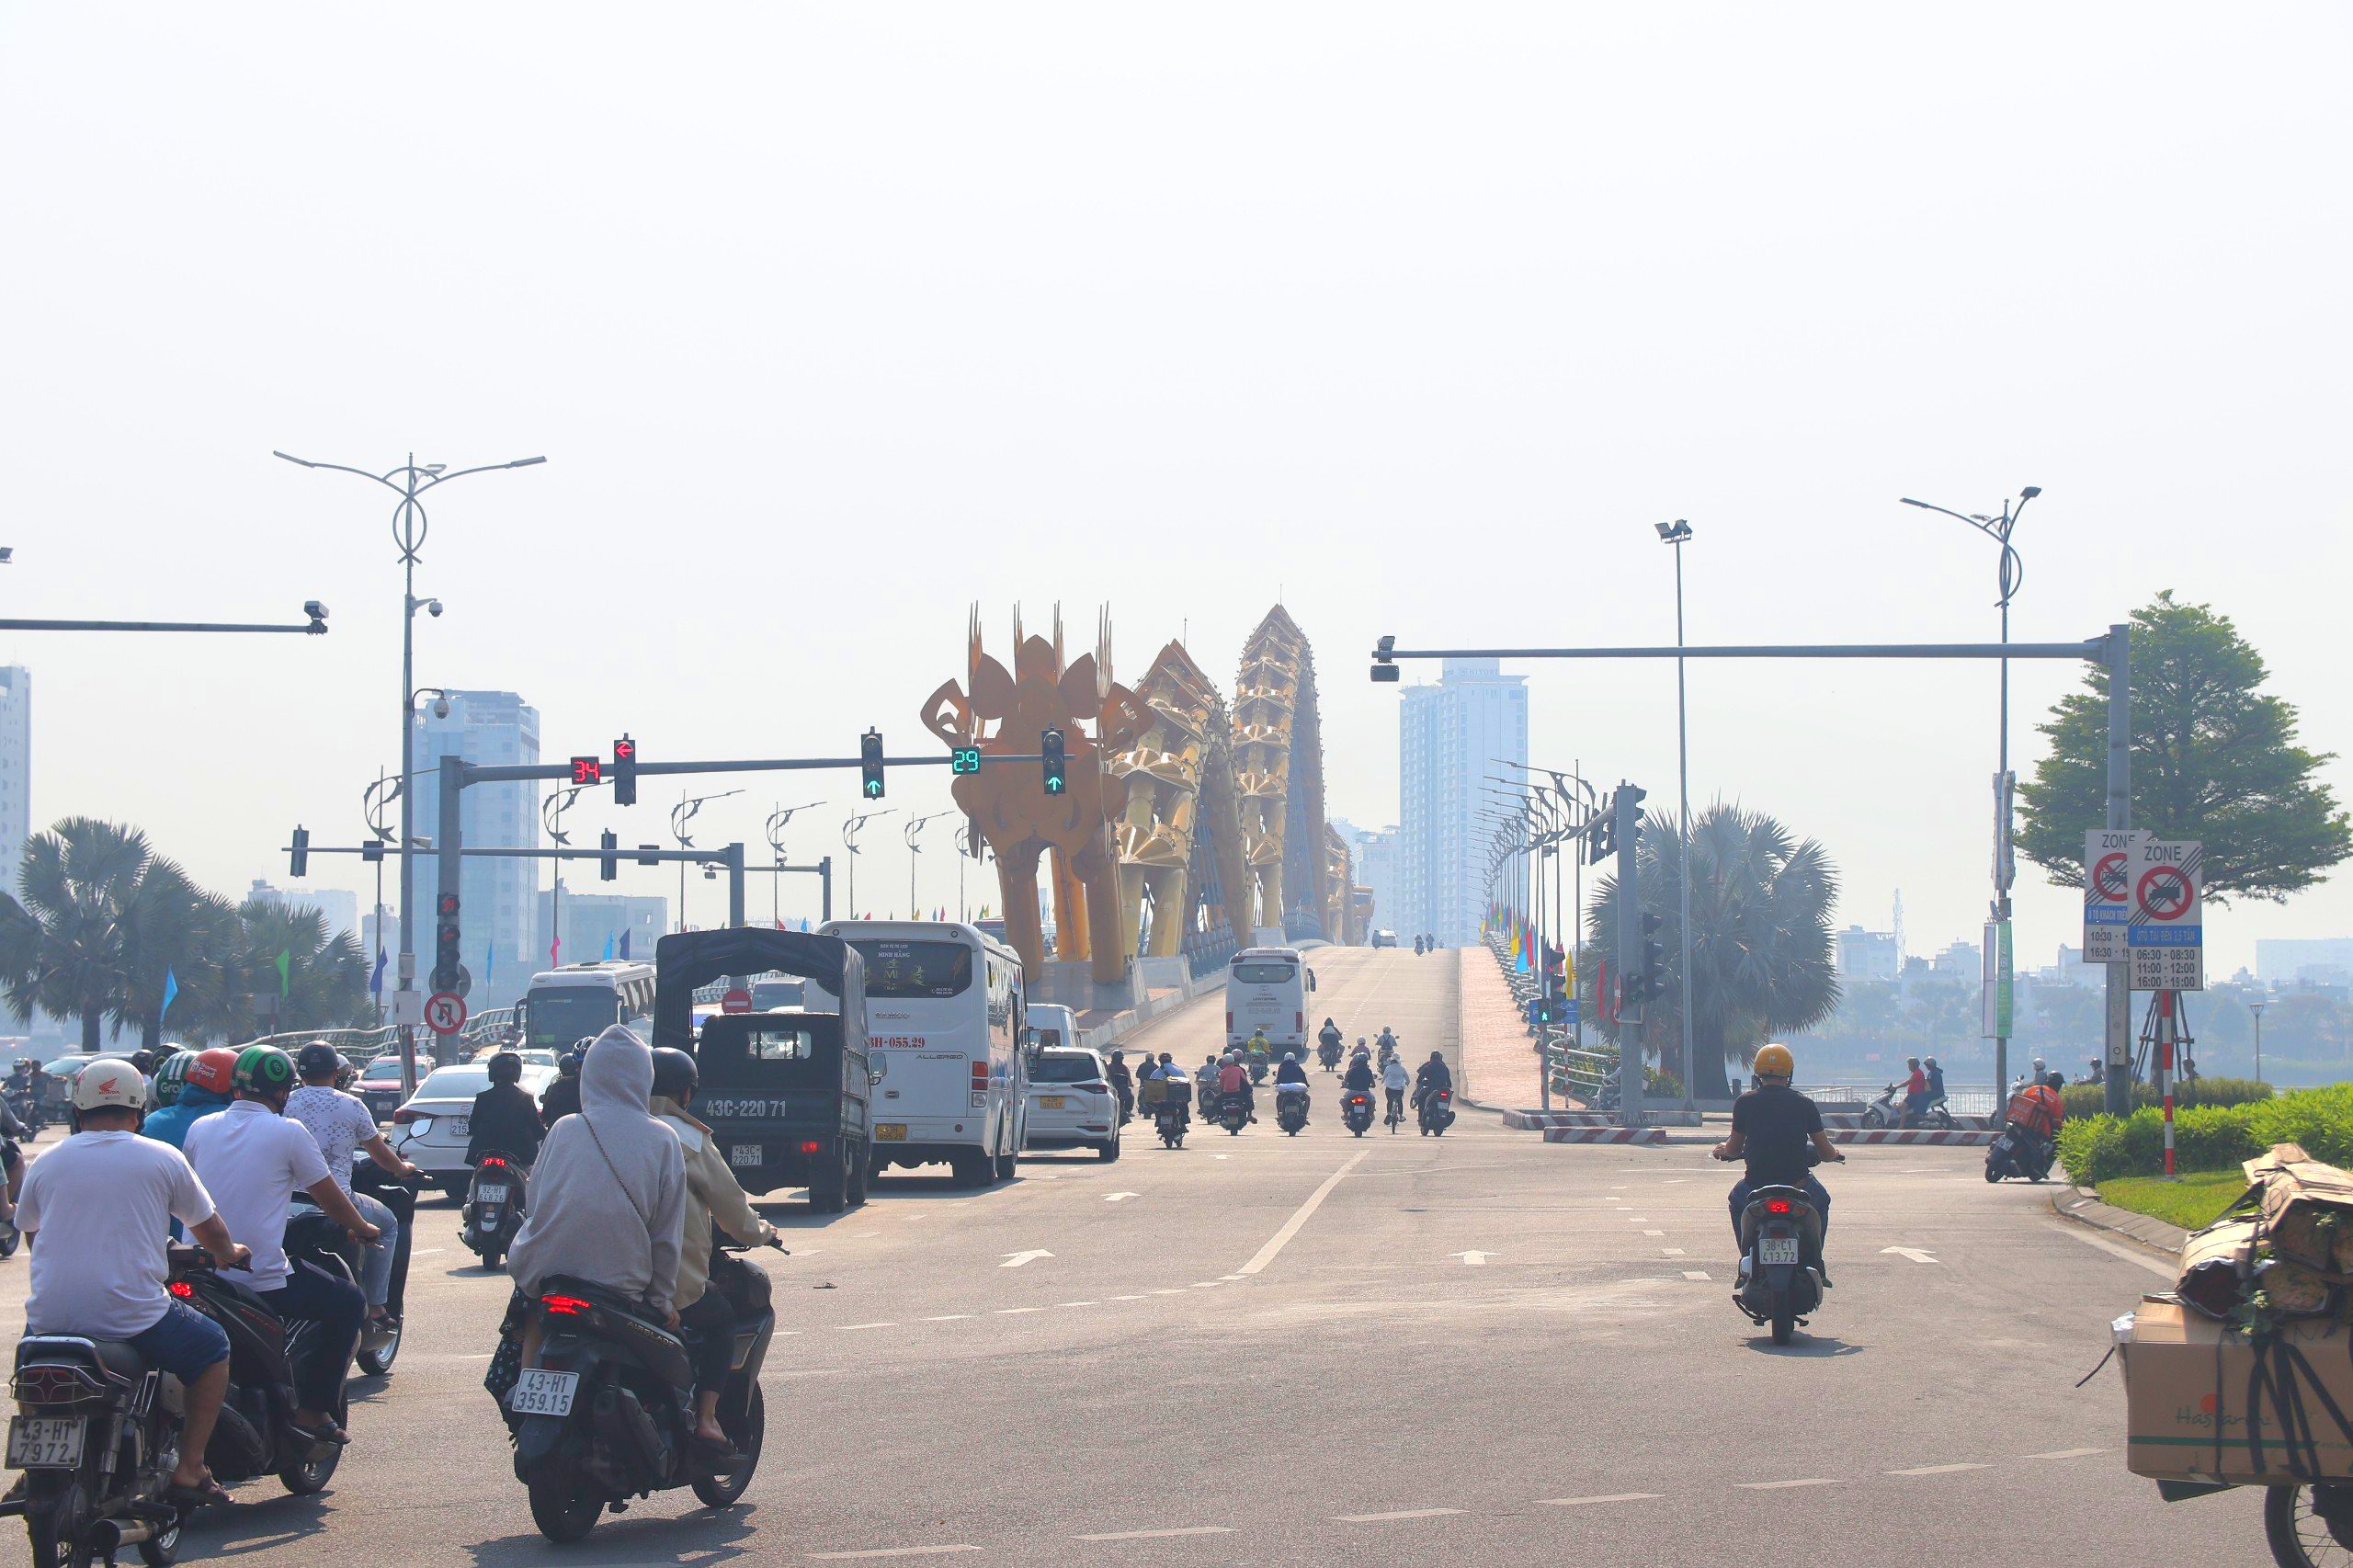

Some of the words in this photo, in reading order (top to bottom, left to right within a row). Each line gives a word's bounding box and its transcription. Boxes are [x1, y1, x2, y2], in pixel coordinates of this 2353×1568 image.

[954, 750, 979, 771] 29
[574, 760, 599, 781] 34
[2144, 846, 2182, 861] ZONE
[2091, 931, 2111, 941] 10:30
[2091, 948, 2111, 958] 16:30
[2137, 949, 2161, 960] 06:30
[2170, 949, 2195, 960] 08:30
[2137, 962, 2161, 974] 11:00
[2170, 962, 2195, 974] 12:00
[2137, 976, 2161, 988] 16:00
[706, 1100, 766, 1117] 43C-220
[769, 1100, 786, 1117] 71
[739, 1145, 756, 1155] 43C
[733, 1155, 760, 1165] 220.71
[1762, 1251, 1795, 1263] 413.72
[527, 1373, 568, 1393] 43-H1
[516, 1391, 570, 1413] 359.15
[19, 1442, 70, 1463] 7972
